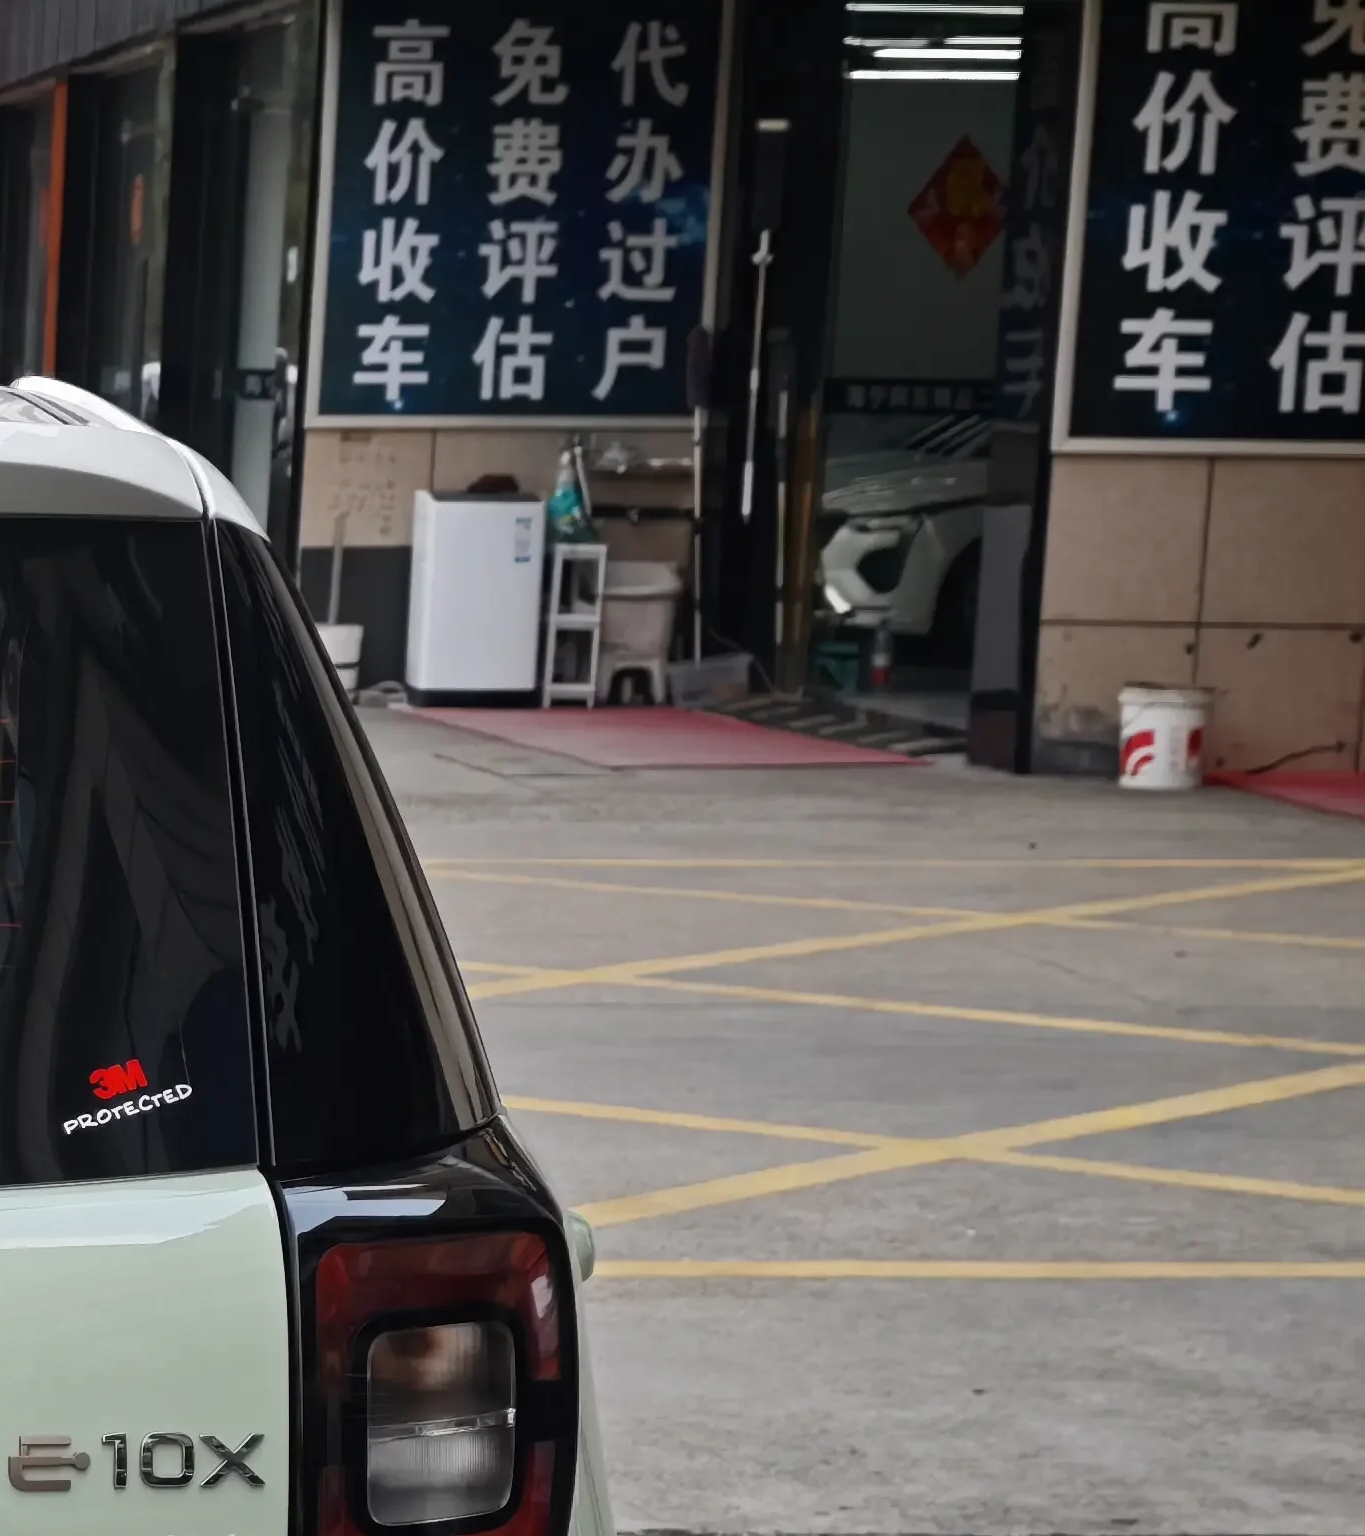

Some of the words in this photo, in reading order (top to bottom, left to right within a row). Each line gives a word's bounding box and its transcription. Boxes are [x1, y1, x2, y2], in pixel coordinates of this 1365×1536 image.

[353, 18, 451, 401] 高价收车
[472, 18, 569, 401] 免费评估
[591, 19, 690, 401] 代办过户
[88, 1058, 148, 1099] 3M
